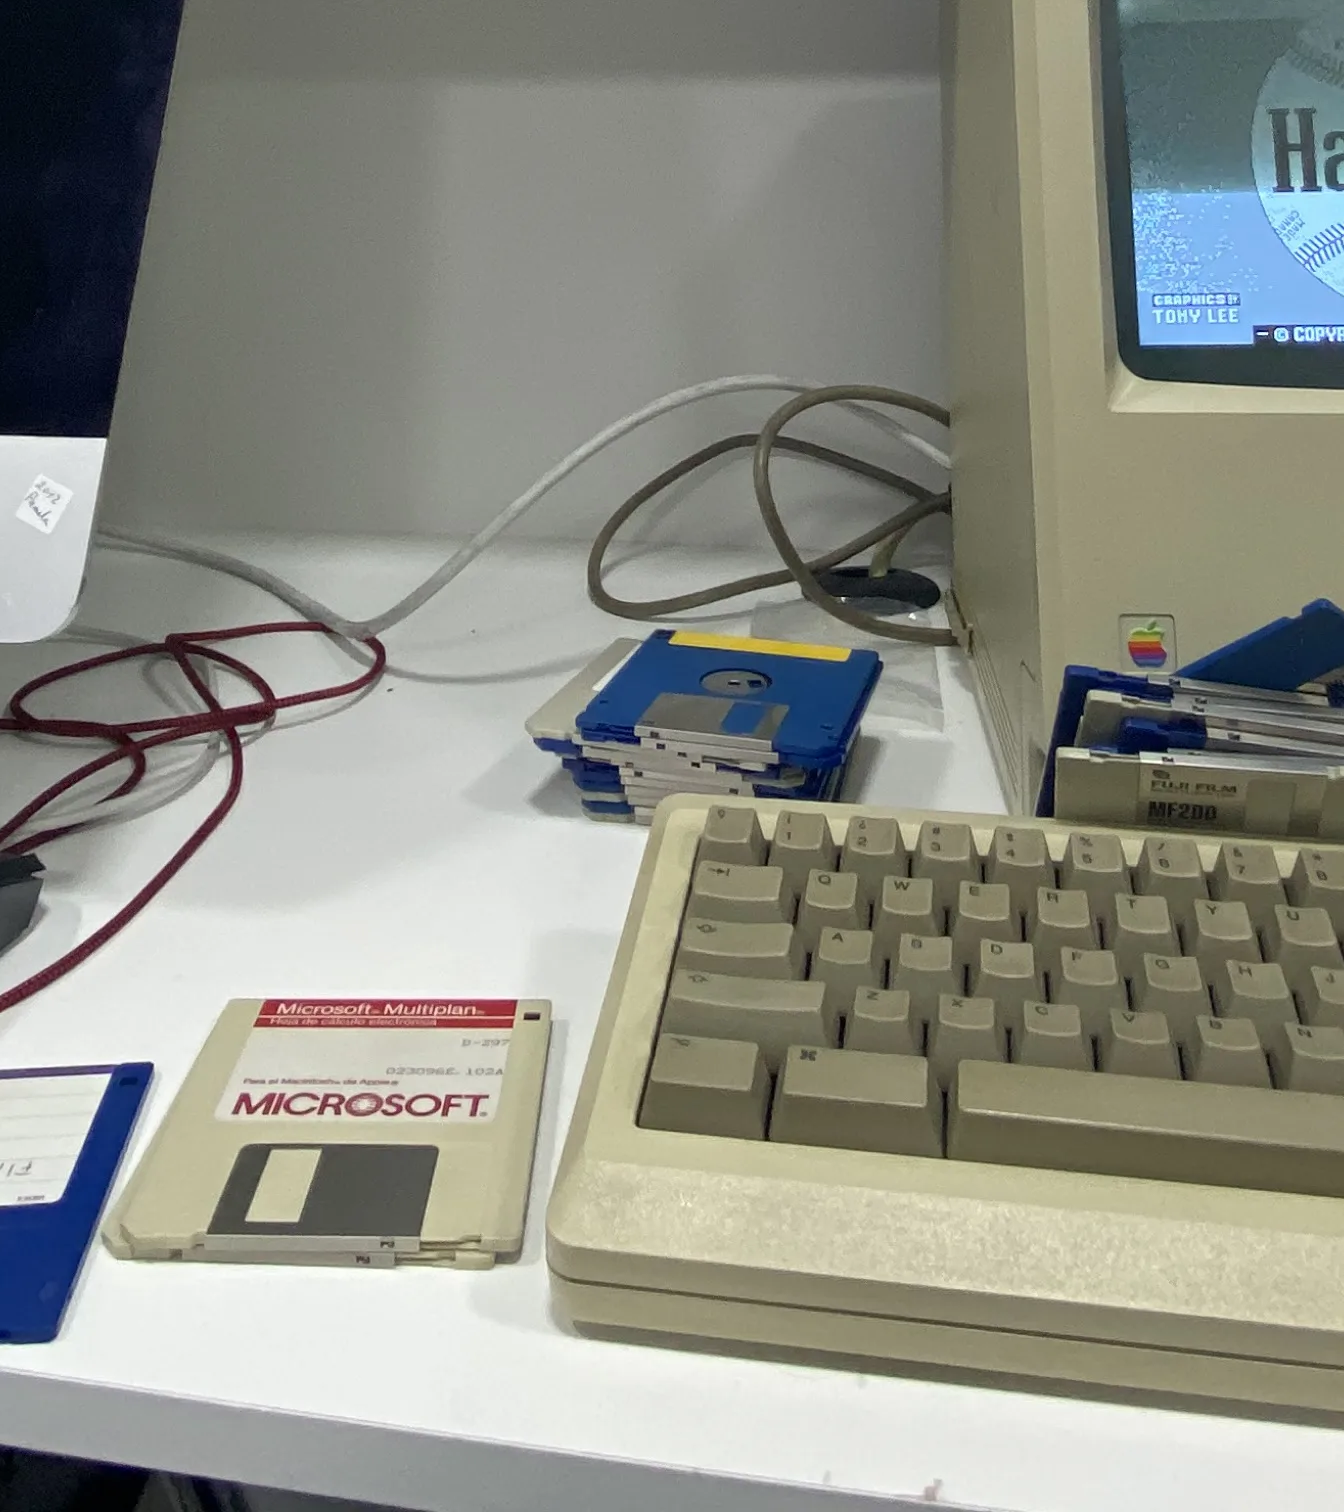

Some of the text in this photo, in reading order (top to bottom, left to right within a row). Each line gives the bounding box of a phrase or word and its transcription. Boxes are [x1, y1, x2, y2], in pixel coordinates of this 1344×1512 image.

[1153, 294, 1226, 306] GRAPHICS
[1152, 307, 1239, 324] TONY LEE
[817, 874, 832, 886] Q
[894, 880, 911, 891] W
[1286, 910, 1300, 922] U
[831, 932, 844, 942] A
[990, 943, 1004, 955] D
[1238, 964, 1254, 977] H
[867, 990, 879, 1001] Z
[277, 1002, 478, 1017] Microsoft Multiplan
[1035, 1005, 1049, 1016] C
[1121, 1011, 1136, 1023] V
[231, 1092, 489, 1117] MICROSOFT
